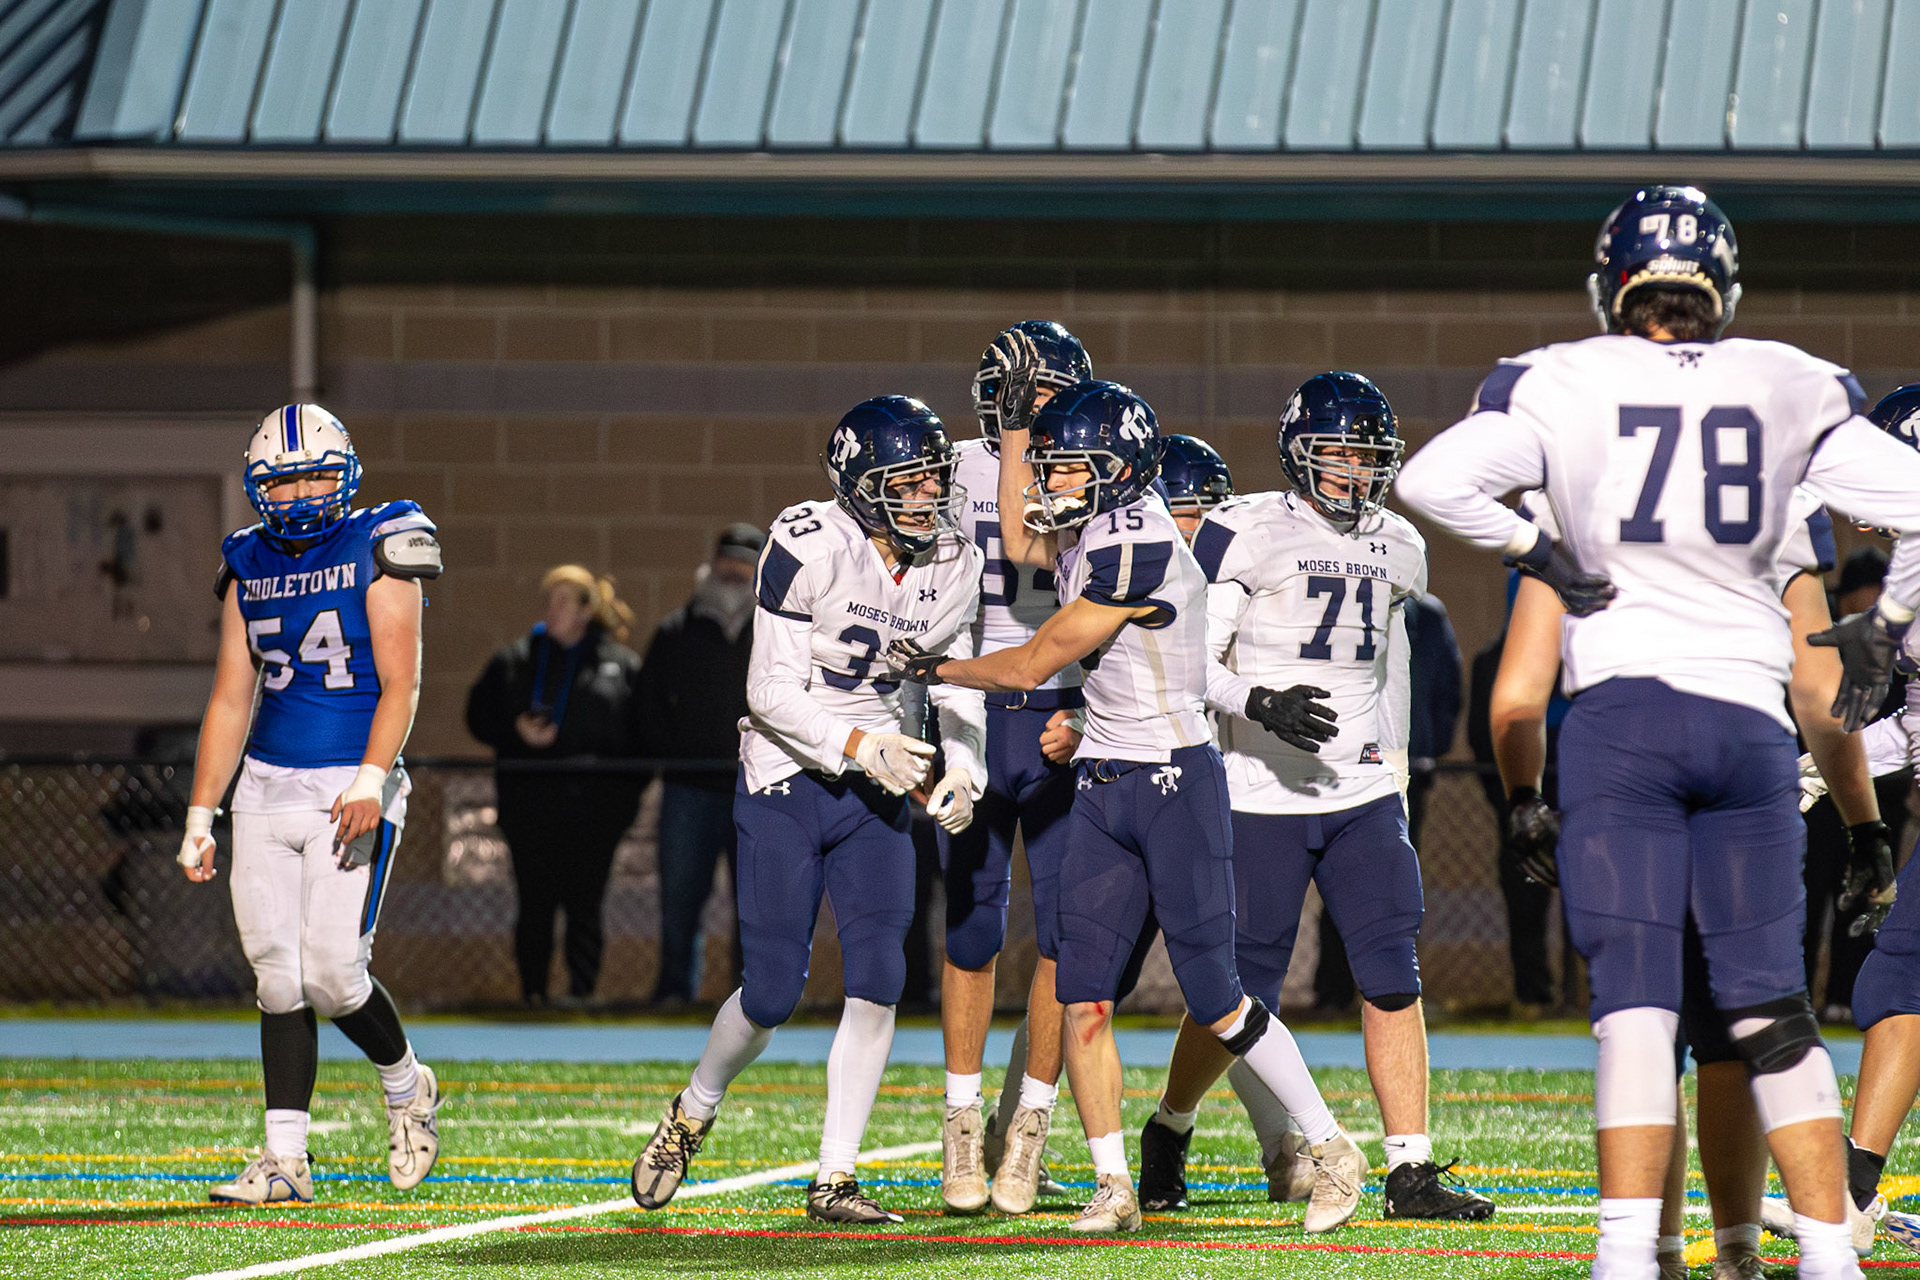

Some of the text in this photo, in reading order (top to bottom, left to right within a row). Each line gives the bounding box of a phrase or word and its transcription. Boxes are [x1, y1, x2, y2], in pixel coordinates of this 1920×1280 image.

[1639, 213, 1698, 245] 78
[1618, 404, 1764, 544] 78
[780, 507, 822, 538] 33
[1108, 508, 1144, 535] 15
[1297, 560, 1388, 580] MOSES BROWN
[846, 601, 929, 632] MOSES BROWN
[1299, 575, 1377, 661] 71
[247, 607, 356, 691] 54
